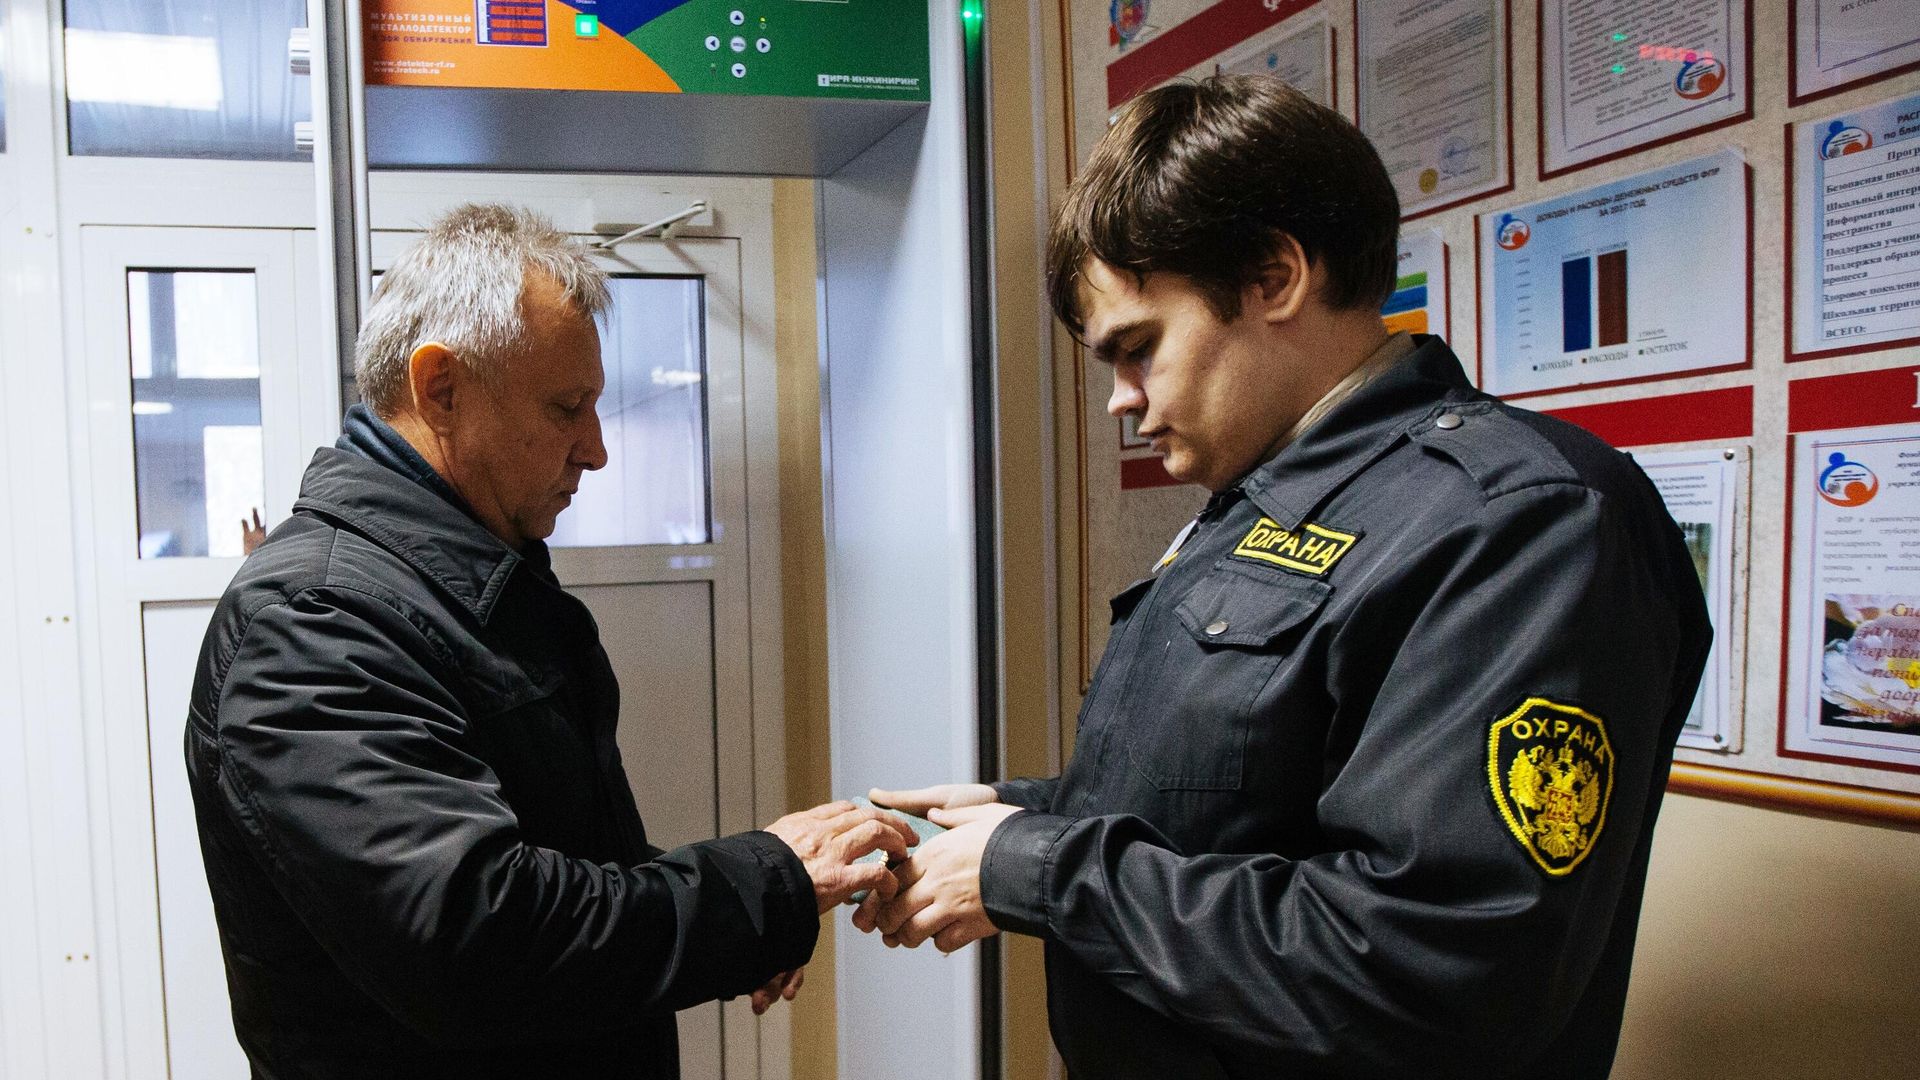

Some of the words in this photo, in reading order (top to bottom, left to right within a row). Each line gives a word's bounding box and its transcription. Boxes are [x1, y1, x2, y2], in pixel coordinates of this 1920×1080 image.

[370, 13, 472, 23] МУЛЬТИЗОННЫЙ
[370, 23, 472, 34] МЕТАЛЛОДЕТЕКТОР
[1883, 131, 1897, 141] по
[1826, 175, 1884, 194] Безопасная
[1826, 192, 1884, 212] Школьный
[1823, 220, 1893, 241] пространства
[1826, 241, 1883, 257] Поддержка
[1826, 257, 1883, 273] Поддержка
[1822, 306, 1877, 321] Школьная
[1826, 325, 1867, 338] ВСЕГО:
[1588, 350, 1629, 364] РАСХОДЫ
[1645, 340, 1689, 356] ОСТАТОК
[1246, 528, 1337, 565] ОХРАНА
[1511, 717, 1607, 765] ОХРАНА
